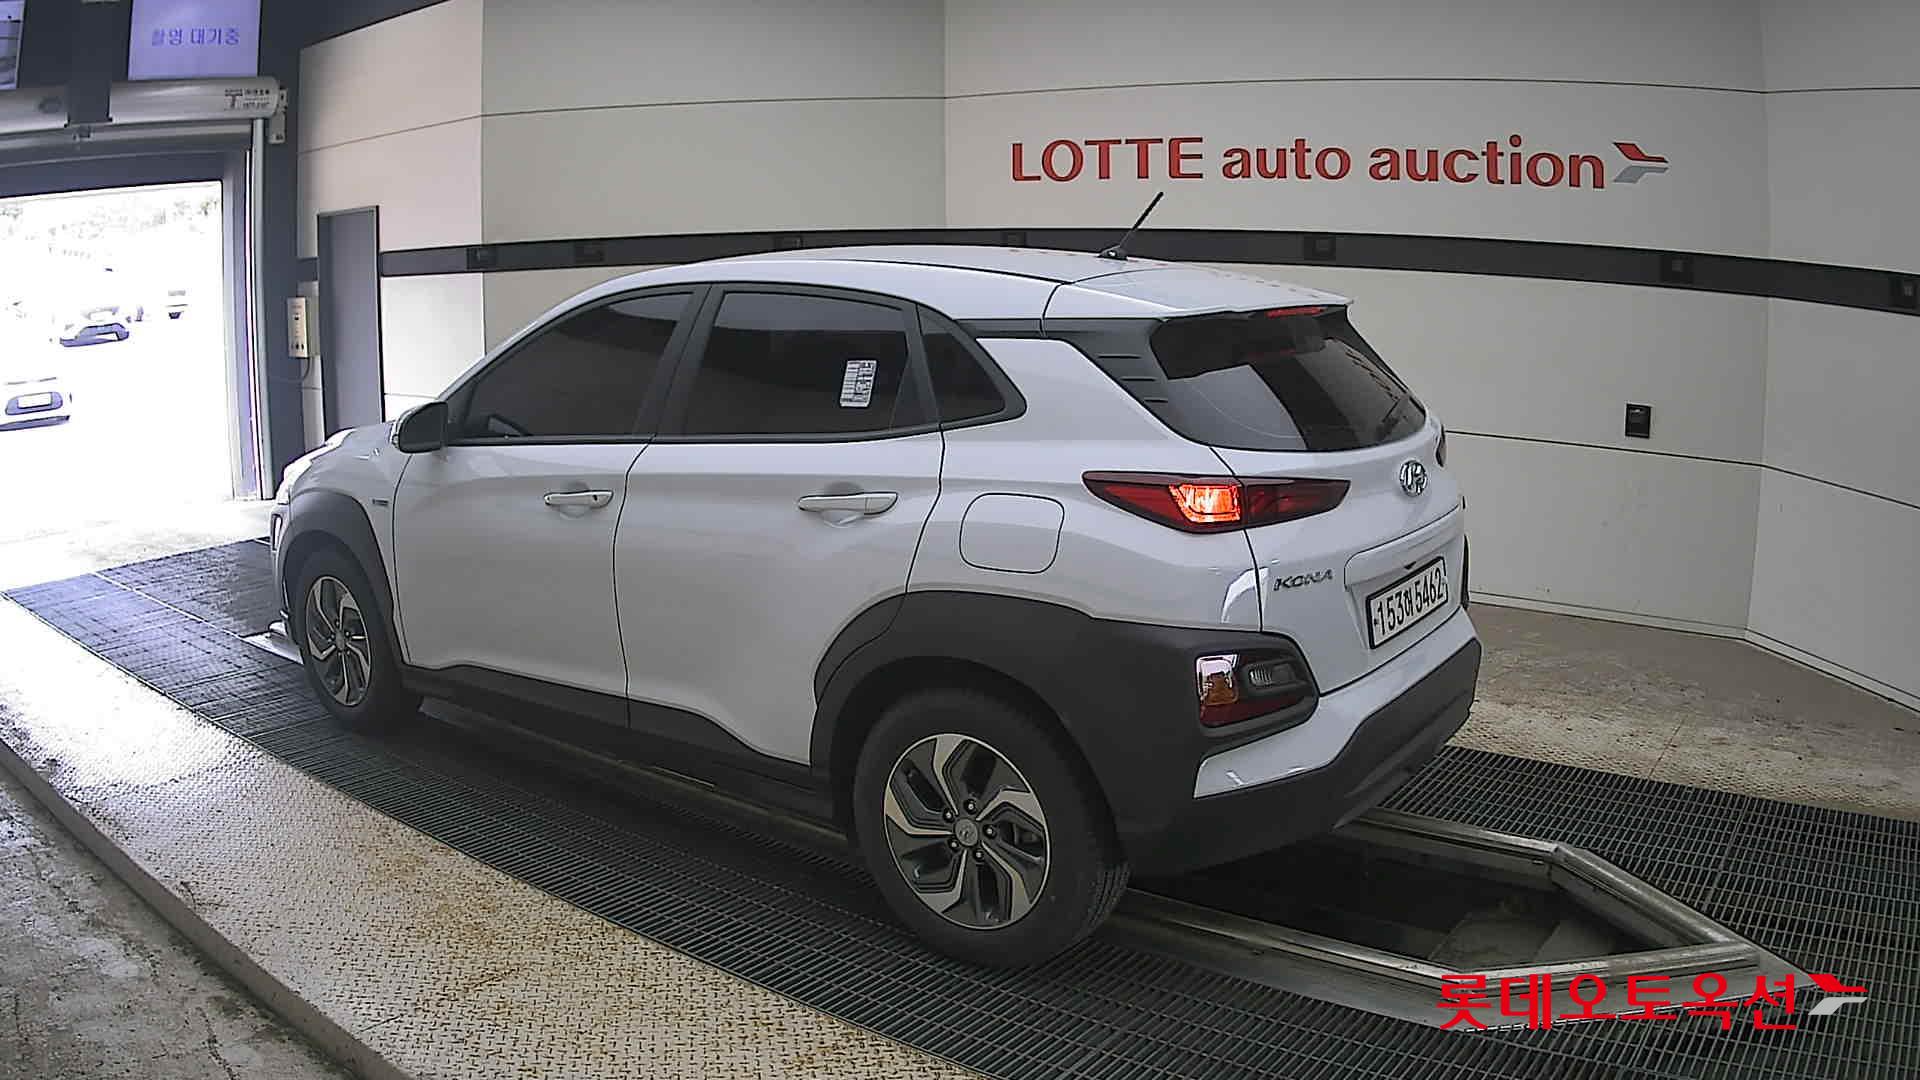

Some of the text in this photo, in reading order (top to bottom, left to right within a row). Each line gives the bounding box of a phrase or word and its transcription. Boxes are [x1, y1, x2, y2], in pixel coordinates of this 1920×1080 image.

[190, 26, 241, 46] 대기중
[1012, 135, 1605, 189] LOTTE auto auction
[1273, 569, 1333, 591] KONA
[1414, 568, 1444, 612] 5462
